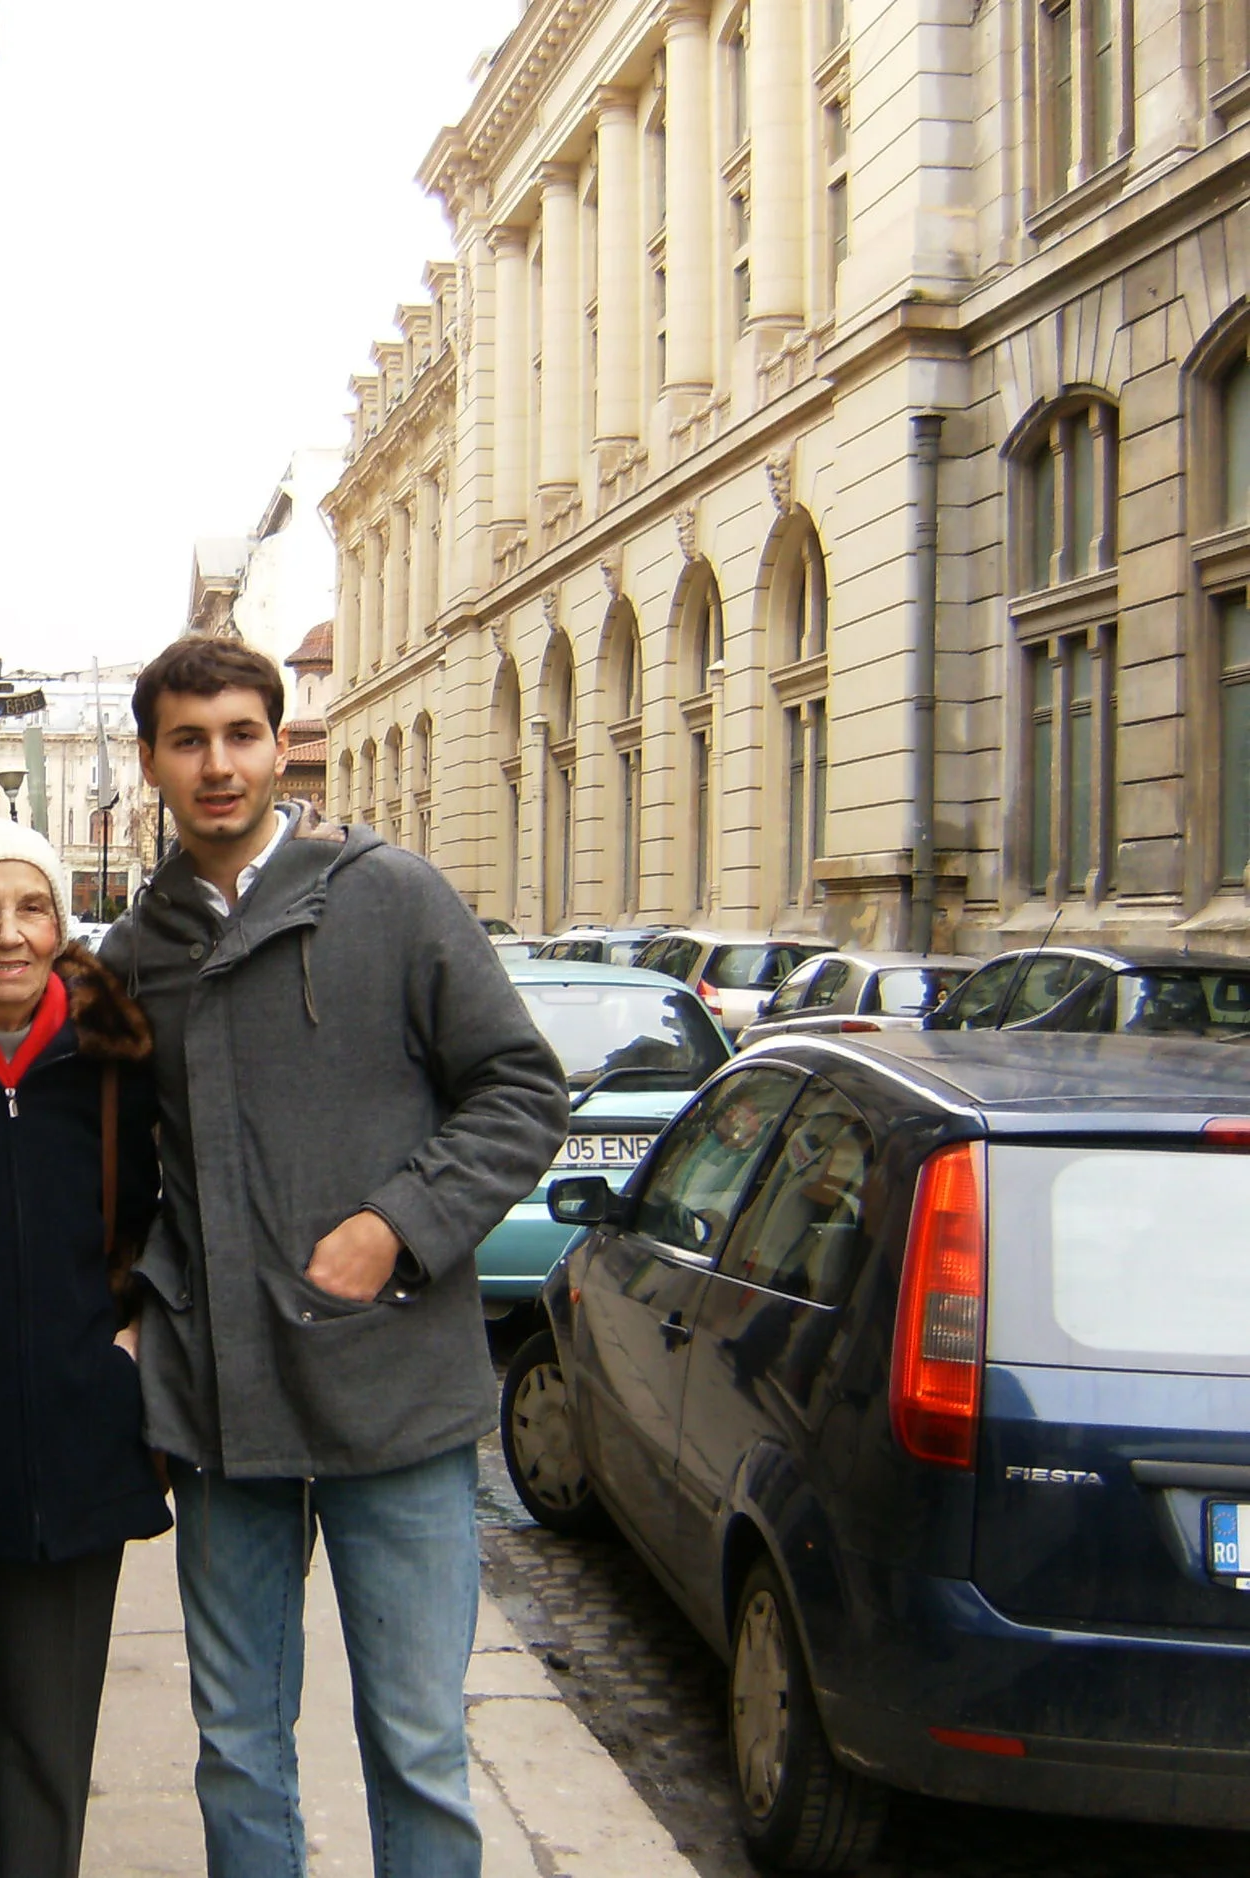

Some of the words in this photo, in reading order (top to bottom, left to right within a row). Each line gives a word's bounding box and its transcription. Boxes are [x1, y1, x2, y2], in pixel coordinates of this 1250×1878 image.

[566, 1137, 595, 1160] 05
[1006, 1466, 1105, 1485] FIESTA
[1214, 1542, 1237, 1563] RO
